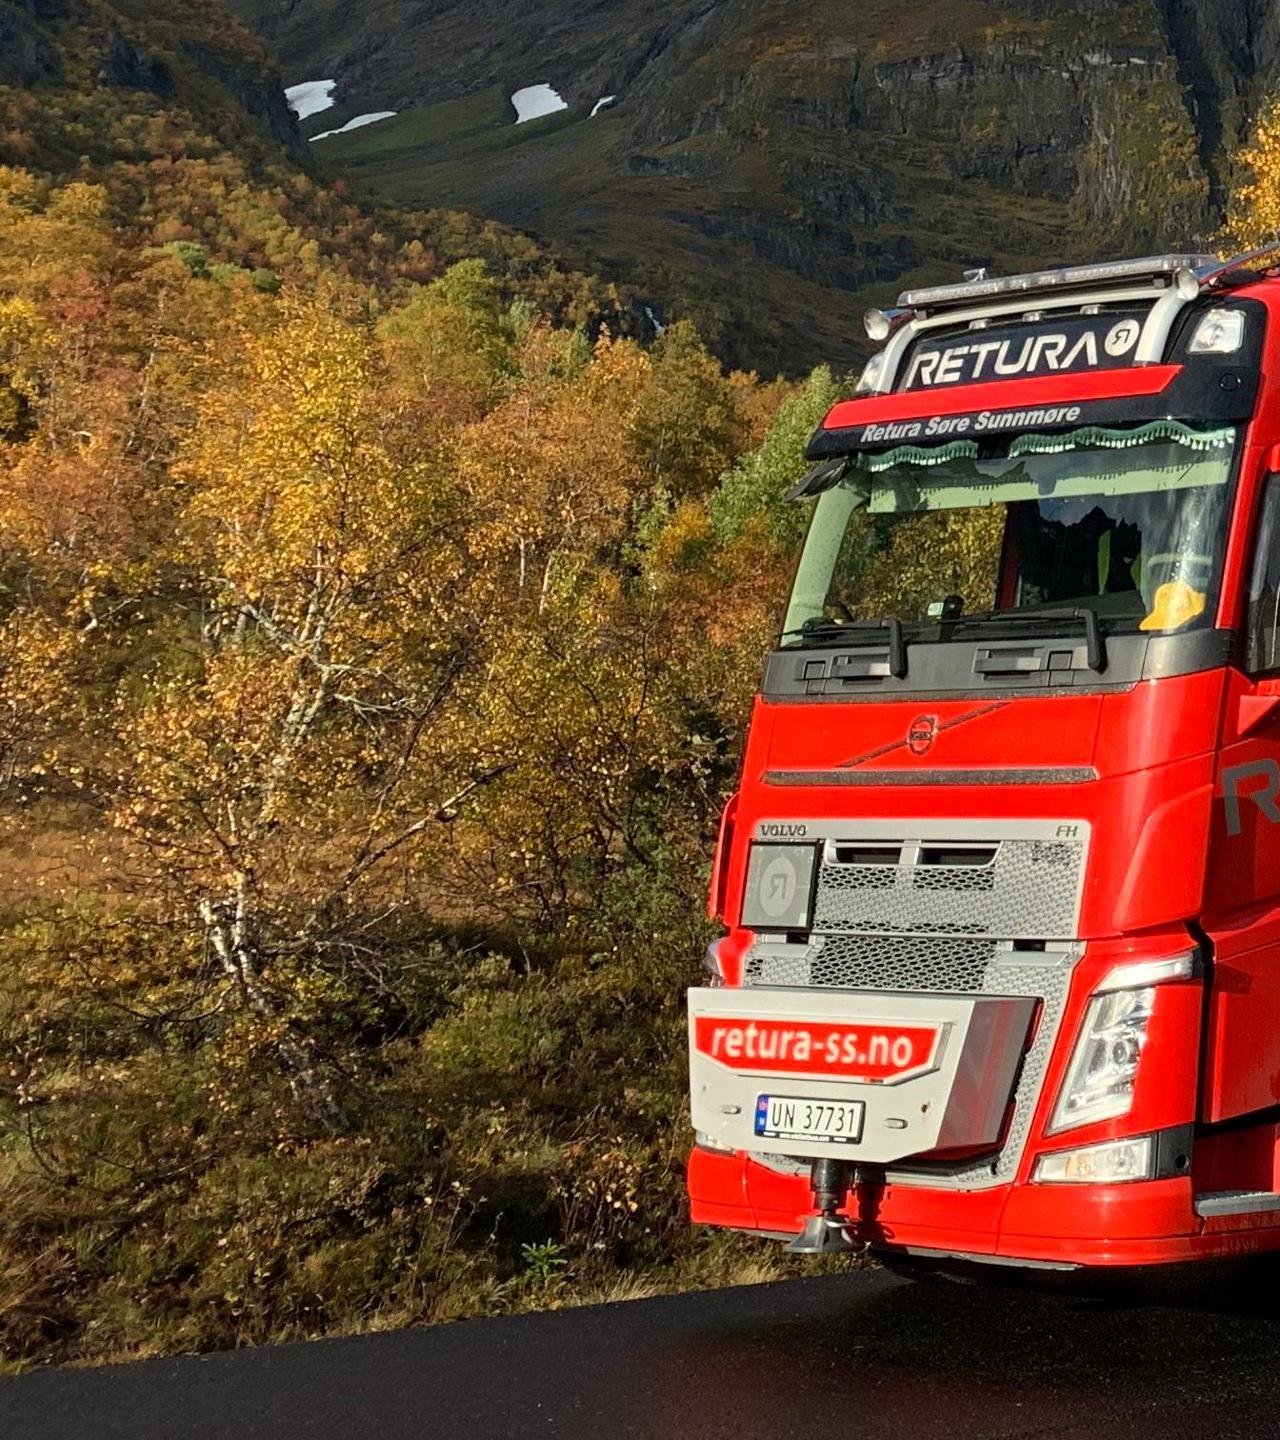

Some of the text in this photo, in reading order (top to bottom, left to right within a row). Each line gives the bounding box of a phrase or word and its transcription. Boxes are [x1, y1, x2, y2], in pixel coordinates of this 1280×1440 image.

[905, 331, 1098, 389] RETURA
[860, 405, 1082, 443] Retura Søre Sunnmøre
[761, 823, 808, 838] VOLVO
[1056, 824, 1078, 838] FH
[710, 1021, 913, 1068] retura-ss.no
[772, 1103, 855, 1134] UN 37731
